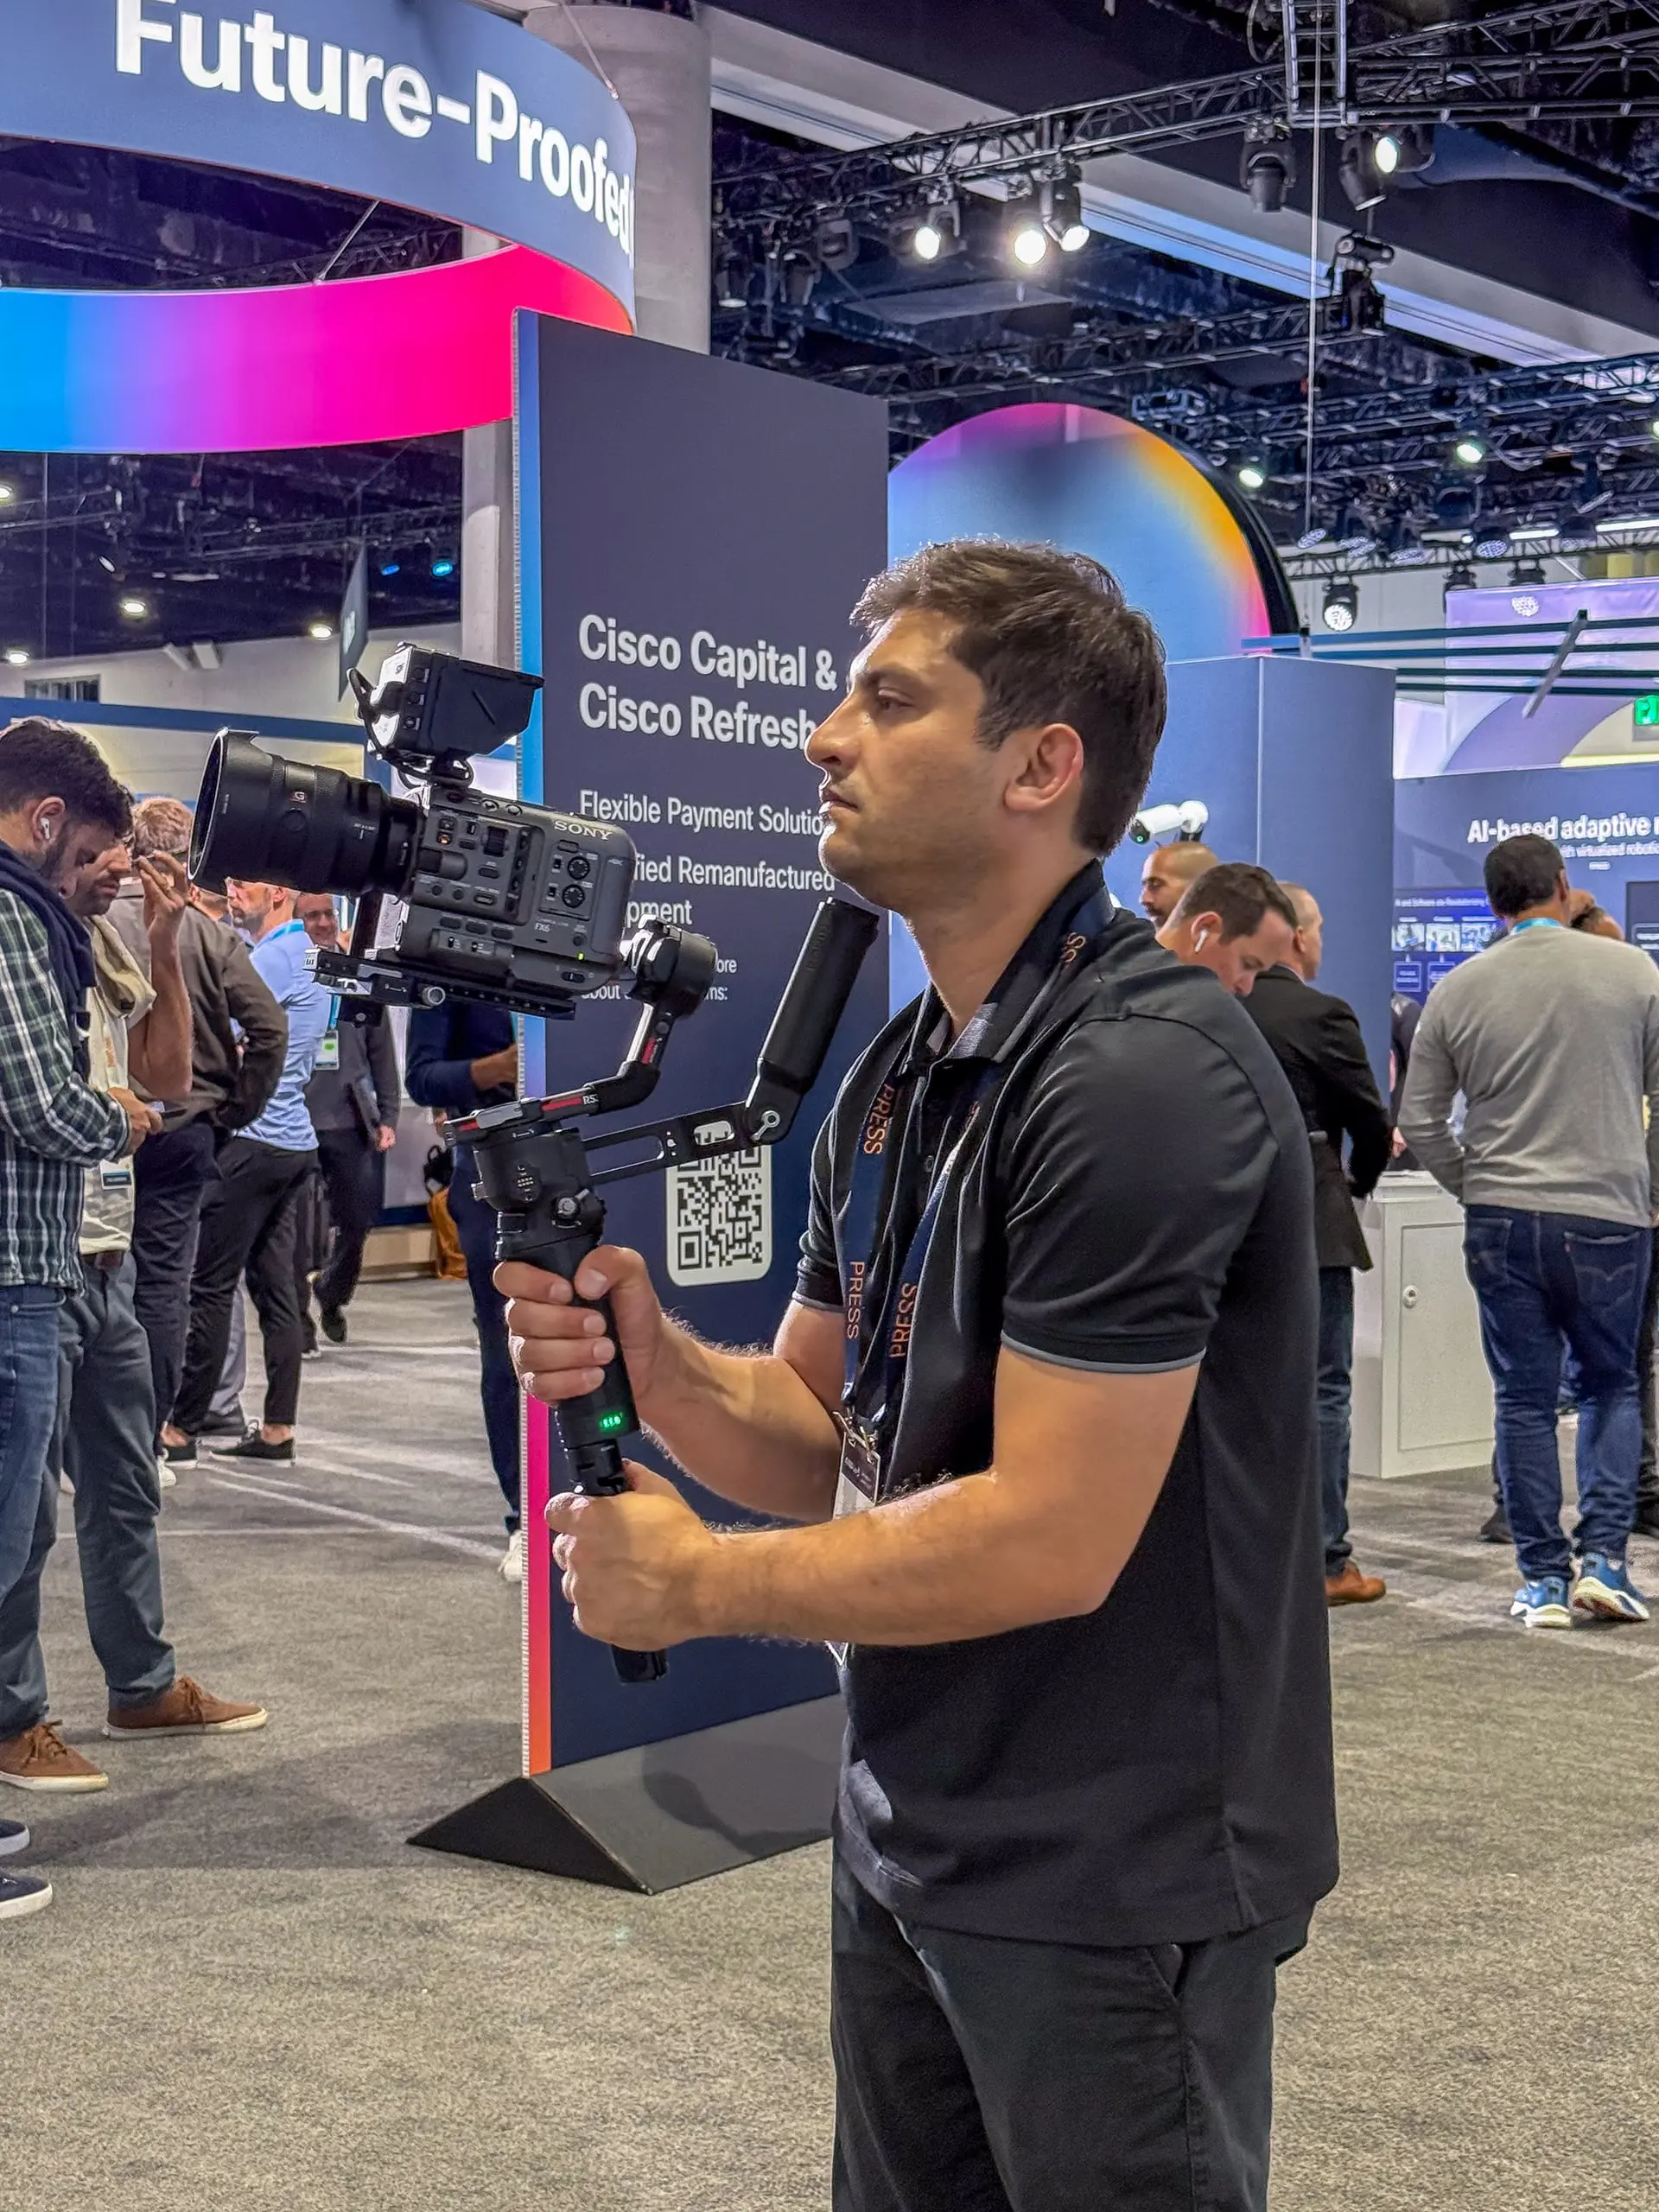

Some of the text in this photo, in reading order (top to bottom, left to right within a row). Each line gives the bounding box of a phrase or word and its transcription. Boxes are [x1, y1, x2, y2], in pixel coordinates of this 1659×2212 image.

[579, 613, 838, 691] Cisco Capital &
[579, 683, 682, 736] Cisco
[554, 820, 613, 841] SONY
[580, 789, 823, 836] Flexible Payment Solutio
[1560, 812, 1651, 842] adaptive
[634, 852, 836, 891] fied Remanufactured
[626, 899, 693, 929] pment
[717, 958, 737, 974] ore
[864, 1083, 896, 1155] PRESS
[848, 1261, 866, 1339] PRESS
[888, 1282, 918, 1359] PRESS
